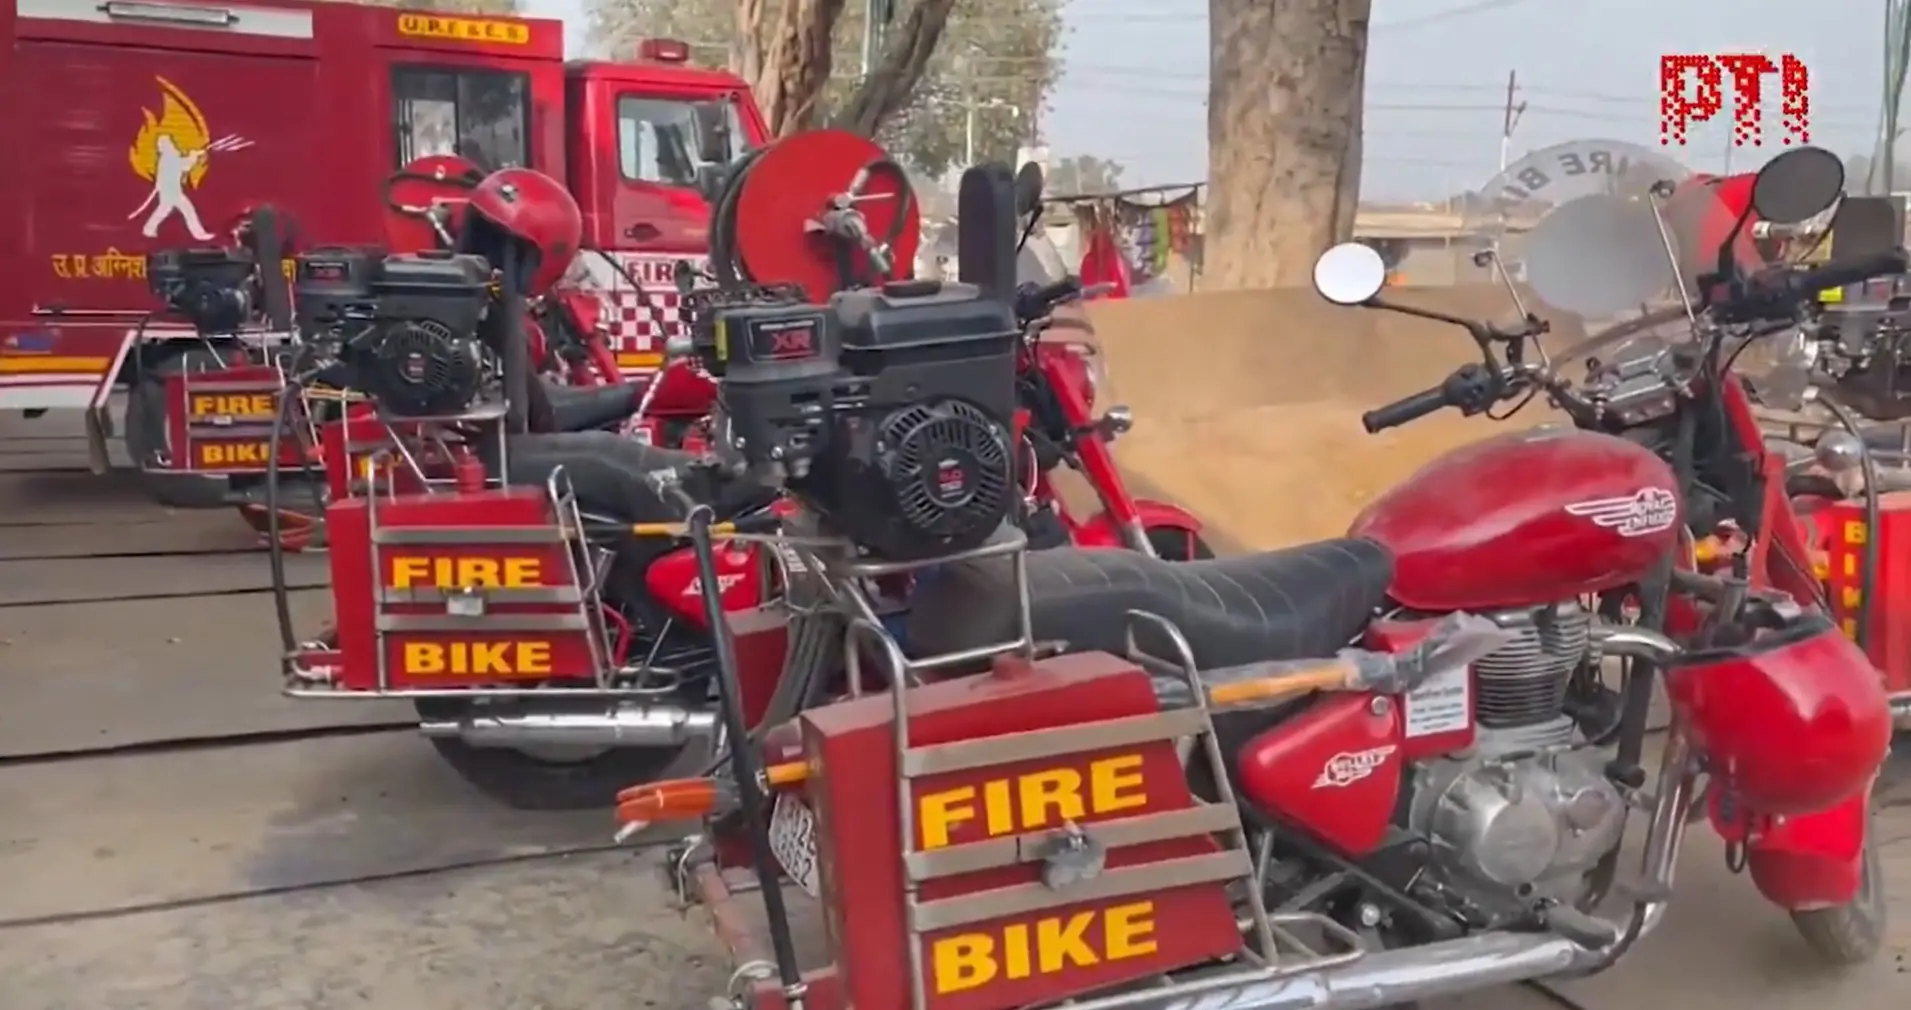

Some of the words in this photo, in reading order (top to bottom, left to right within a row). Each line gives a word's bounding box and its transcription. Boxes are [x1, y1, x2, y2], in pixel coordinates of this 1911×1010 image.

[91, 246, 147, 279] अग्निश
[627, 261, 683, 282] FIR
[194, 395, 272, 416] FIRE
[393, 556, 541, 590] FIRE
[405, 641, 552, 674] BIKE
[919, 753, 1147, 851] FIRE
[932, 901, 1158, 995] BIKE
